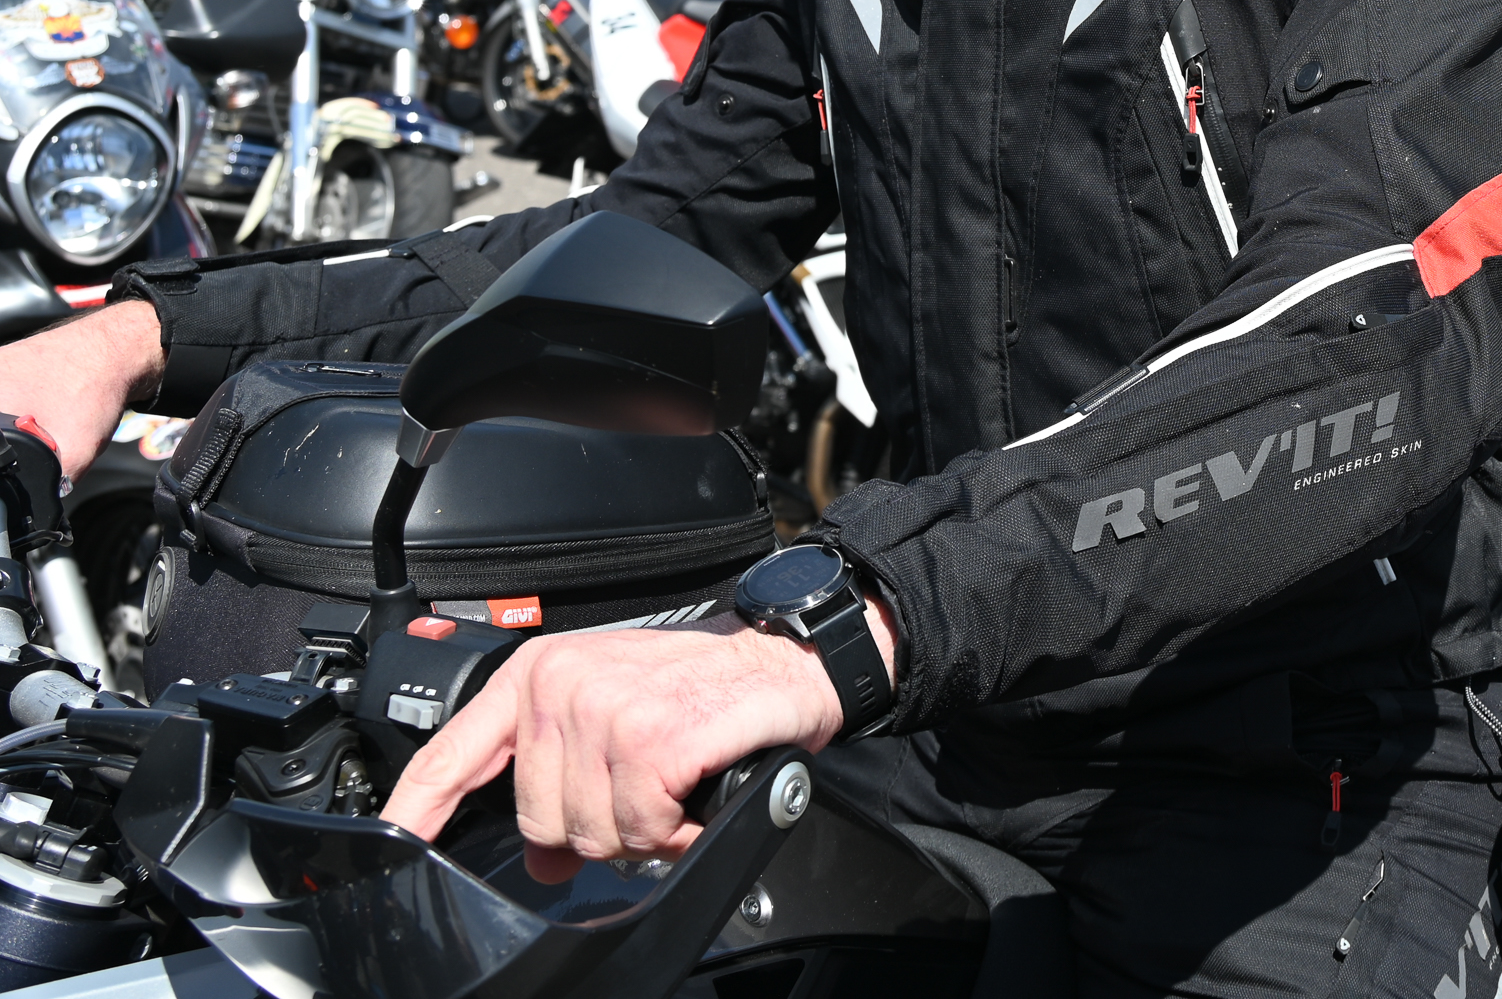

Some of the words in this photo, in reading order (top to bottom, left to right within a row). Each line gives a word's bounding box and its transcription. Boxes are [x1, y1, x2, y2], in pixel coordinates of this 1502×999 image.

[1072, 392, 1401, 553] REV'IT!
[1293, 452, 1382, 491] ENGINEERED
[1390, 439, 1423, 459] SKIN
